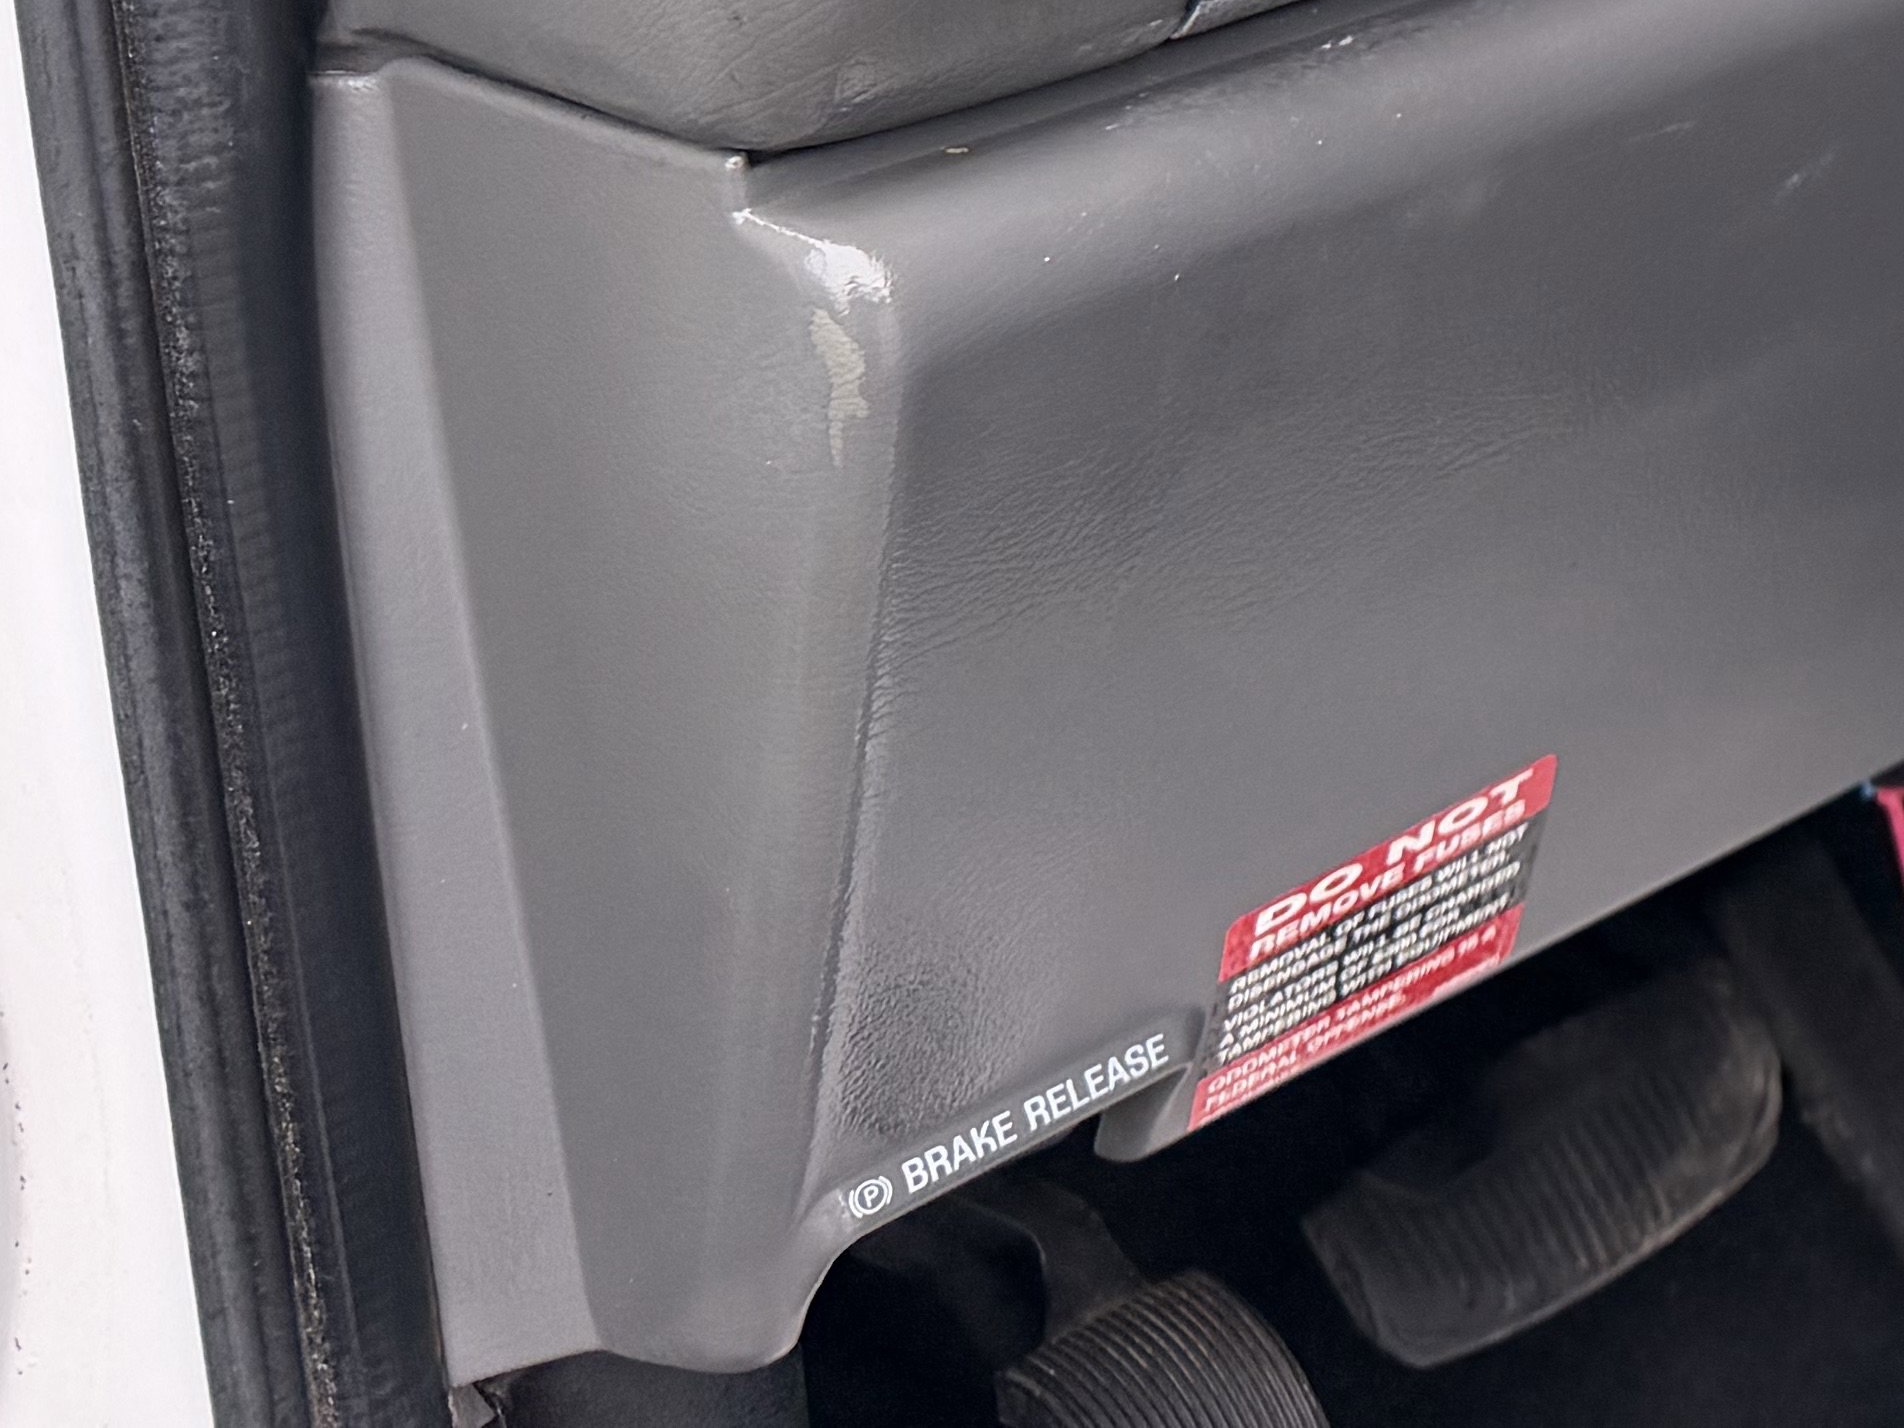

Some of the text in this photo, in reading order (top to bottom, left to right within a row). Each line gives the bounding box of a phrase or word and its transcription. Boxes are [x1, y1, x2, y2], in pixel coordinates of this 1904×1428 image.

[1250, 800, 1524, 960] REMOVE FUSES
[1255, 769, 1532, 936] DO NOT
[1224, 962, 1337, 1031] VIOLATORS
[1230, 933, 1325, 993] REMOVAL
[901, 1110, 1018, 1194] BRAKE
[1023, 1033, 1169, 1132] RELEASE
